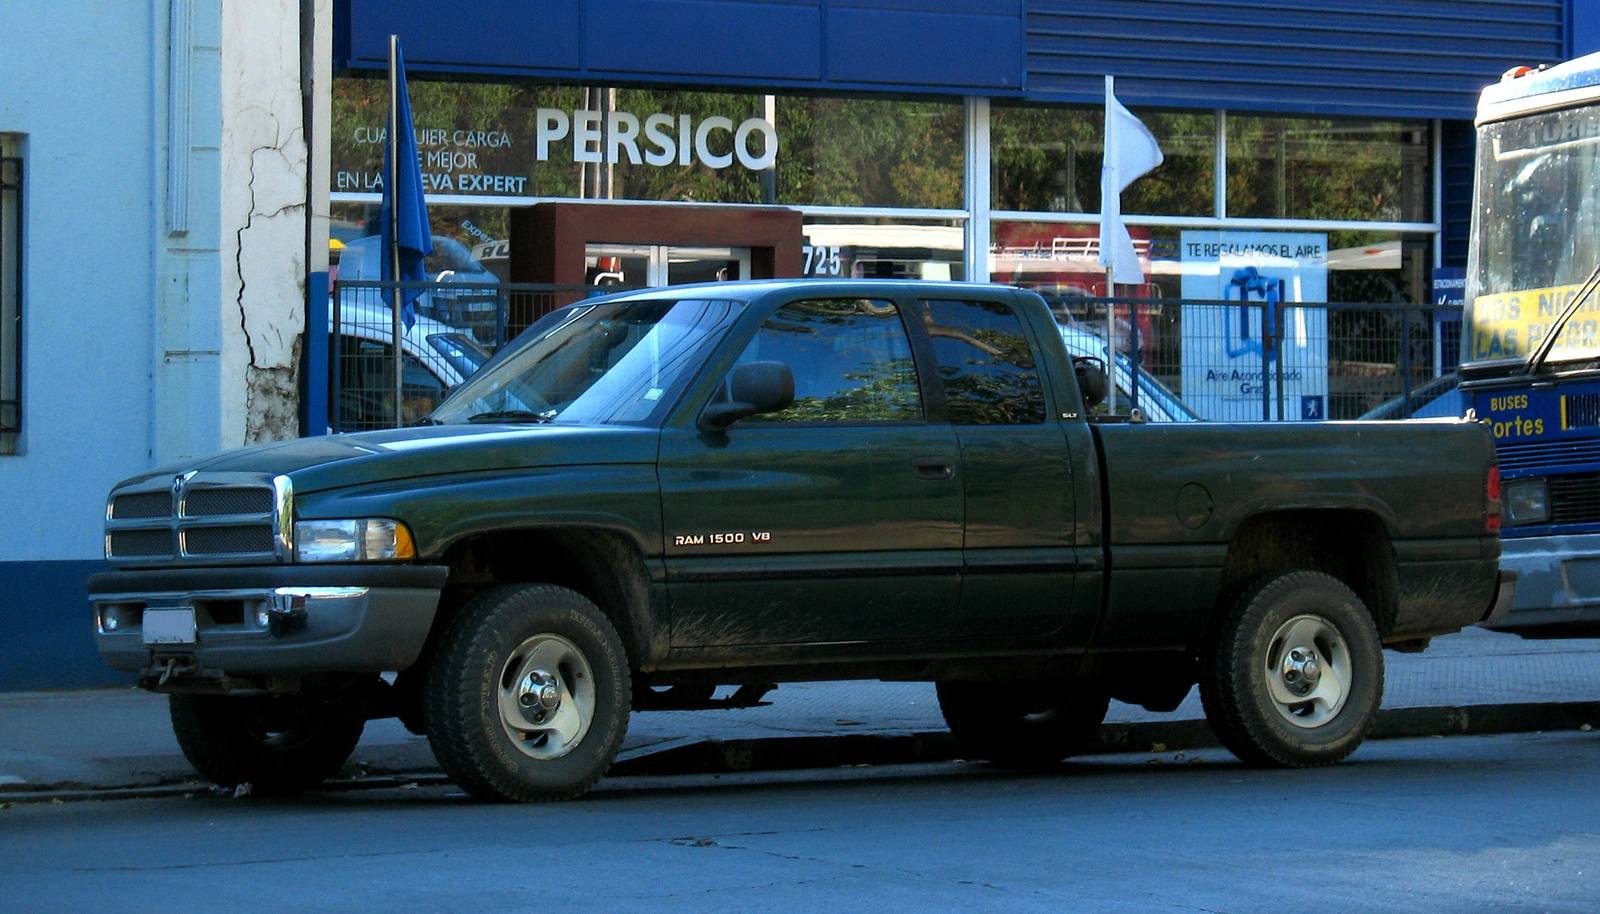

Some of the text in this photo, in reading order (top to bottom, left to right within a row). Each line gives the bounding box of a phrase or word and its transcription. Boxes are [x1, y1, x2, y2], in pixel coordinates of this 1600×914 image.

[354, 127, 512, 148] CUAUIER CARGA
[536, 108, 779, 171] PERSICO
[427, 151, 478, 173] MEJOR
[337, 171, 359, 188] EN
[364, 171, 384, 188] LA
[458, 174, 528, 193] EXPERT
[802, 245, 841, 275] 725
[1186, 243, 1202, 257] TE
[1280, 244, 1293, 258] EL
[1476, 328, 1518, 358] LAS
[1490, 394, 1529, 412] BUSES
[675, 532, 771, 546] RAM 1500 V8
